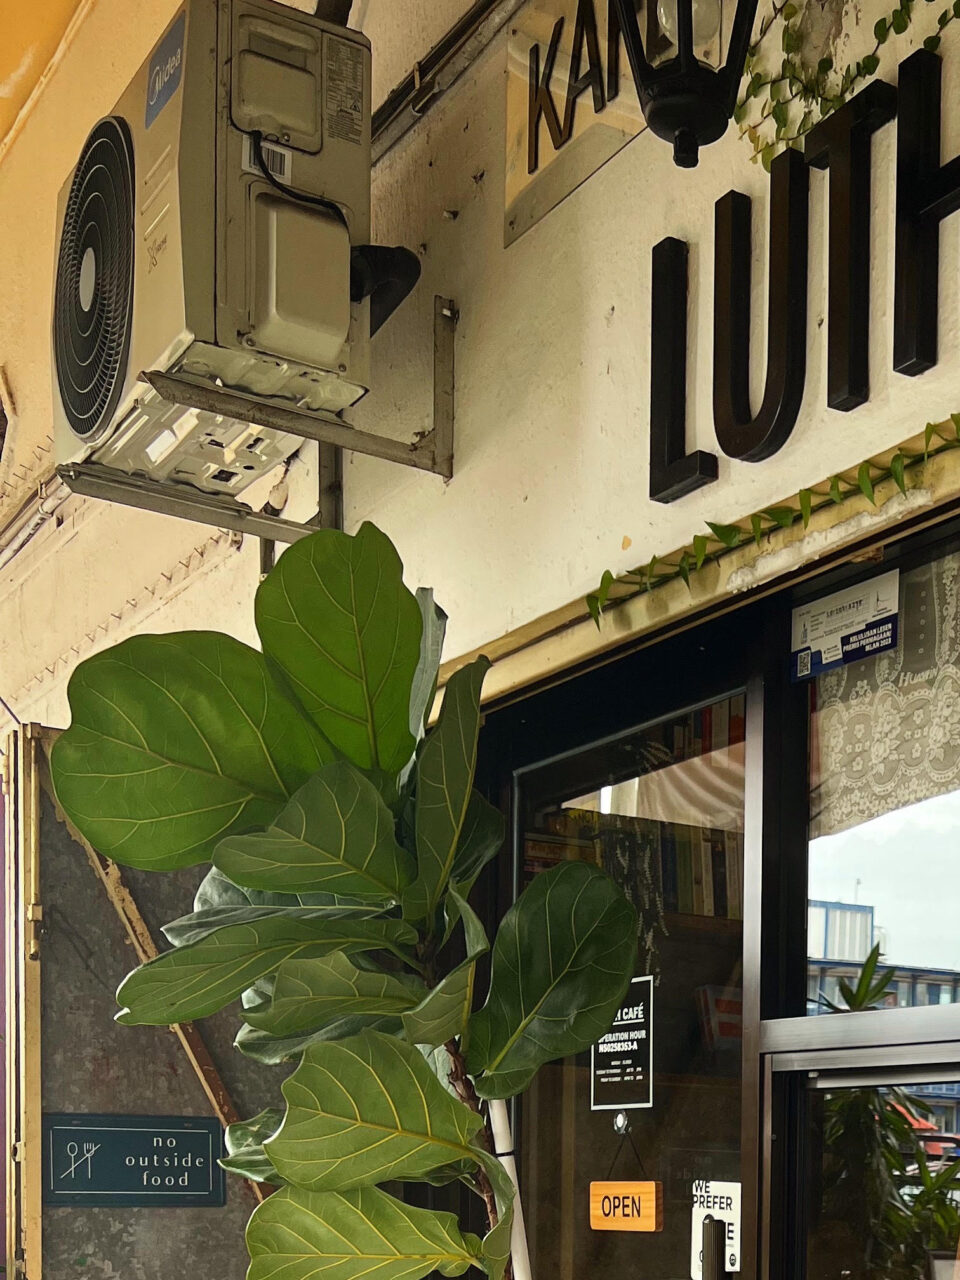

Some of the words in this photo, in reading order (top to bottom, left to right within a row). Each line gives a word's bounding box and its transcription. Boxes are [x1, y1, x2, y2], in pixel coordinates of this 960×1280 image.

[150, 48, 181, 105] Midea
[622, 1002, 644, 1020] CAFÉ
[153, 1137, 176, 1148] no
[125, 1152, 204, 1167] outside
[143, 1171, 189, 1186] food
[694, 1180, 711, 1193] WE
[601, 1195, 641, 1218] OPEN
[692, 1194, 733, 1211] PREFER
